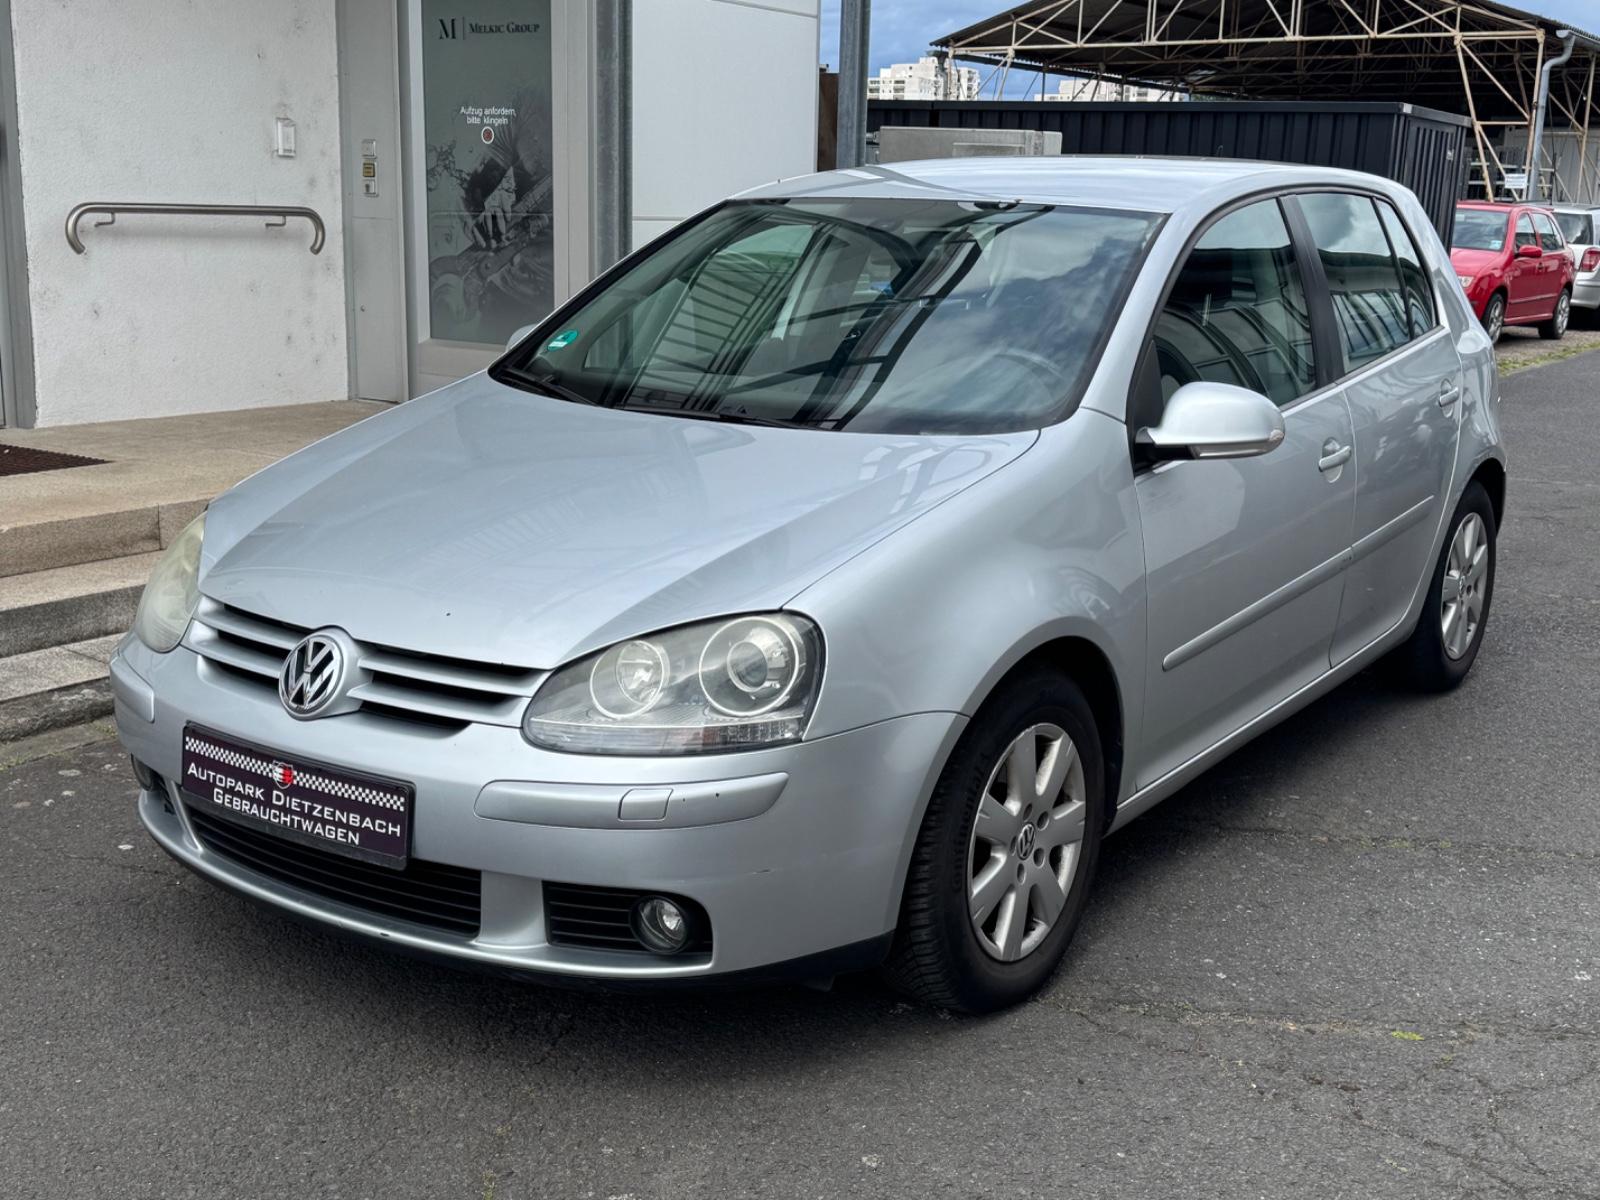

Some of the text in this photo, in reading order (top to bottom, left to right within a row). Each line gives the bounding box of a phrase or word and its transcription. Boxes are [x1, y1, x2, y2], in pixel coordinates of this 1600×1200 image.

[506, 22, 540, 34] GROUP
[460, 106, 483, 117] Aufzug
[467, 115, 509, 127] bitte klingeln
[187, 762, 401, 837] AUTOPARK DIETZENBACH
[213, 788, 360, 846] GEBRAUCHTWAGEN
